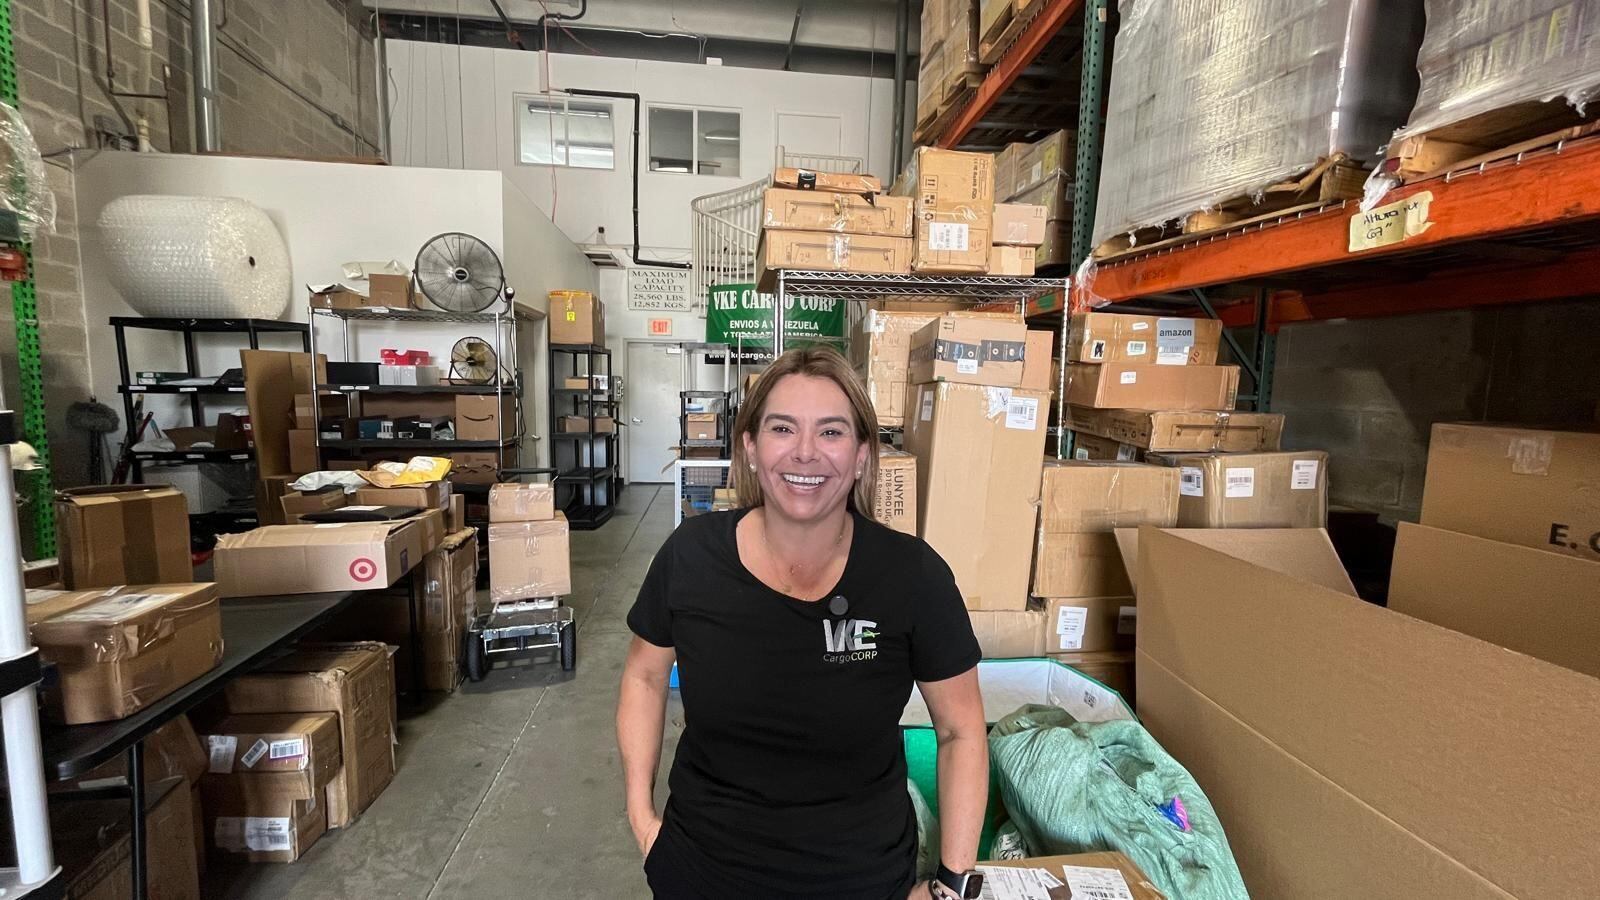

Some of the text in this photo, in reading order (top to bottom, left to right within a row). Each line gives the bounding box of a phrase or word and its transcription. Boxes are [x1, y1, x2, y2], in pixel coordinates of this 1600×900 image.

[632, 270, 687, 278] MAXIMUM
[666, 294, 687, 302] LBS.
[713, 289, 837, 312] VKE CARO CORP
[652, 320, 668, 333] EXIT
[729, 319, 820, 331] ENVIOS A VEZUELA
[1159, 328, 1192, 337] amazon
[894, 468, 904, 516] LUNYEE
